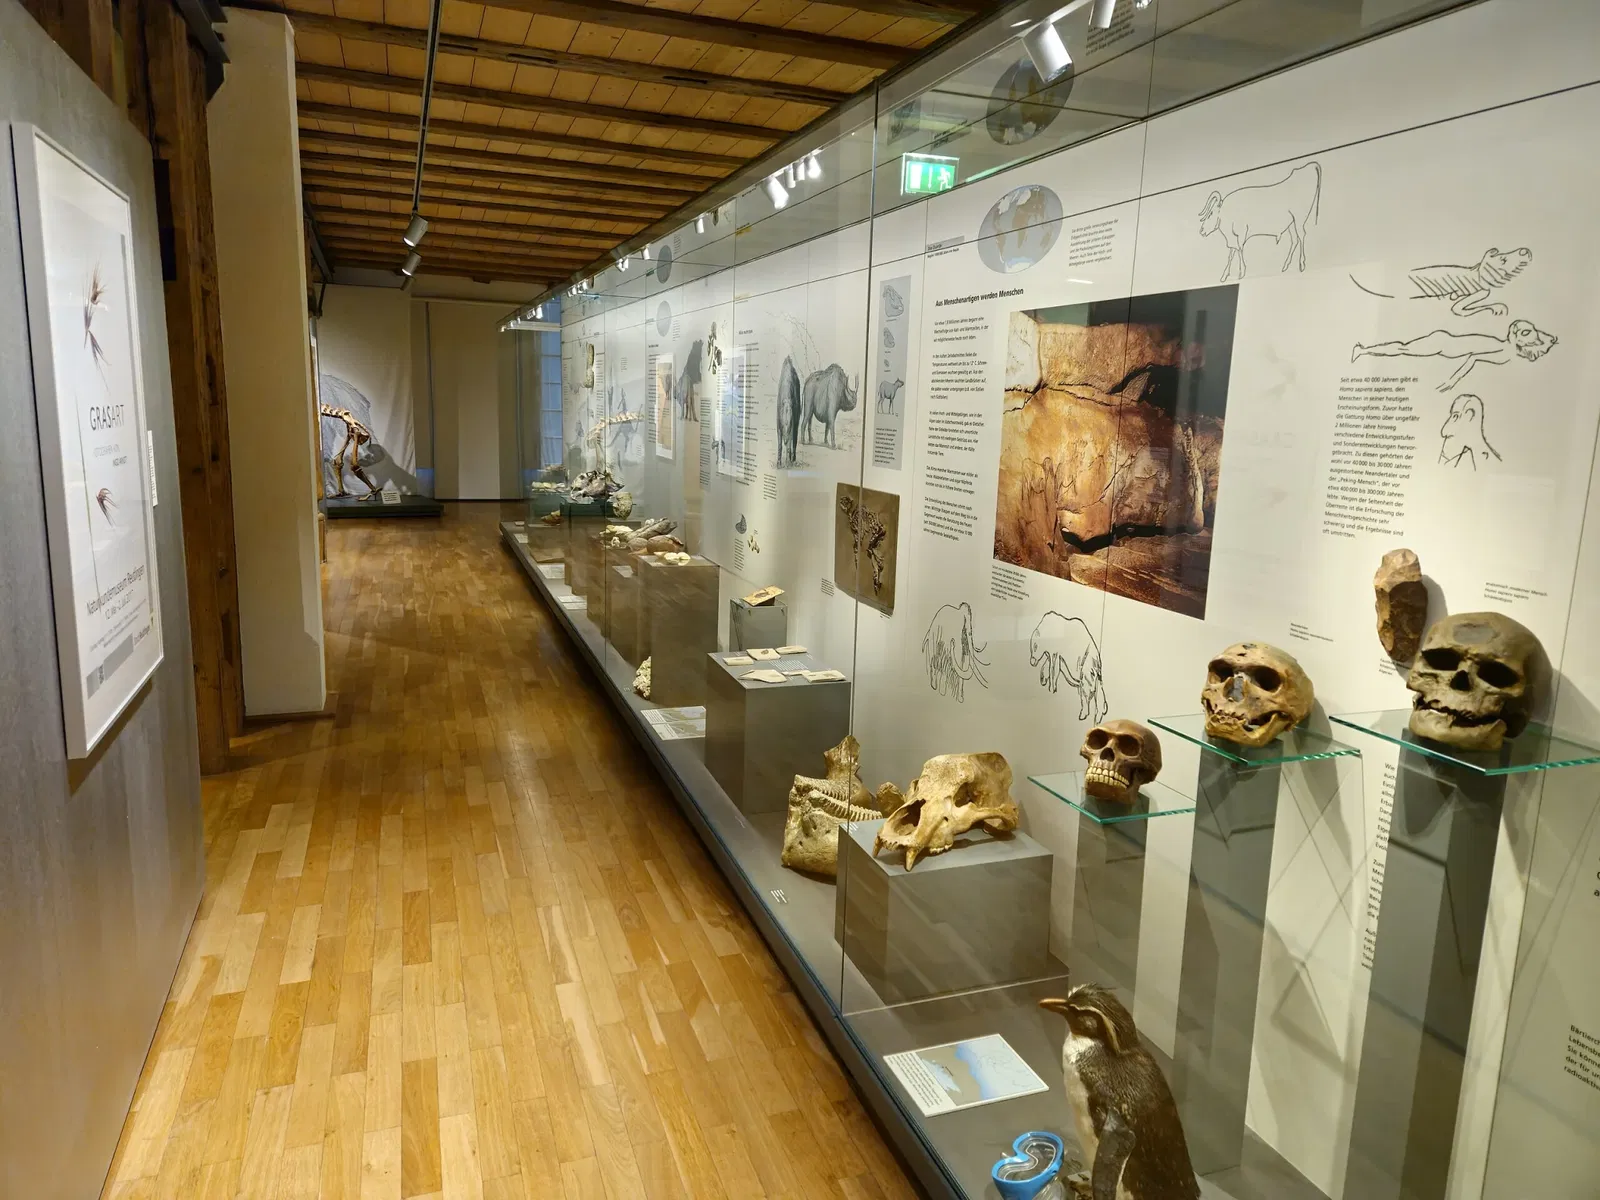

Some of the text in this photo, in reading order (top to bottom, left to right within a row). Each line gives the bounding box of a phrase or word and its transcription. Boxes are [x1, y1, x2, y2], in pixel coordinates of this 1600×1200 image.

[944, 295, 979, 306] Menschenartigen
[980, 292, 997, 300] werden
[999, 288, 1023, 297] Menschen
[90, 404, 124, 430] GRASART
[1366, 433, 1415, 441] Entwicklungsstufen
[1344, 441, 1396, 450] Sonderentwicklungen
[1365, 507, 1394, 516] Erforschung
[1325, 511, 1377, 523] Menschheitsgeschichte
[1366, 526, 1391, 535] Ergebnisse
[1567, 1044, 1577, 1054] Sie
[1566, 1056, 1577, 1065] der
[1580, 1062, 1590, 1072] für
